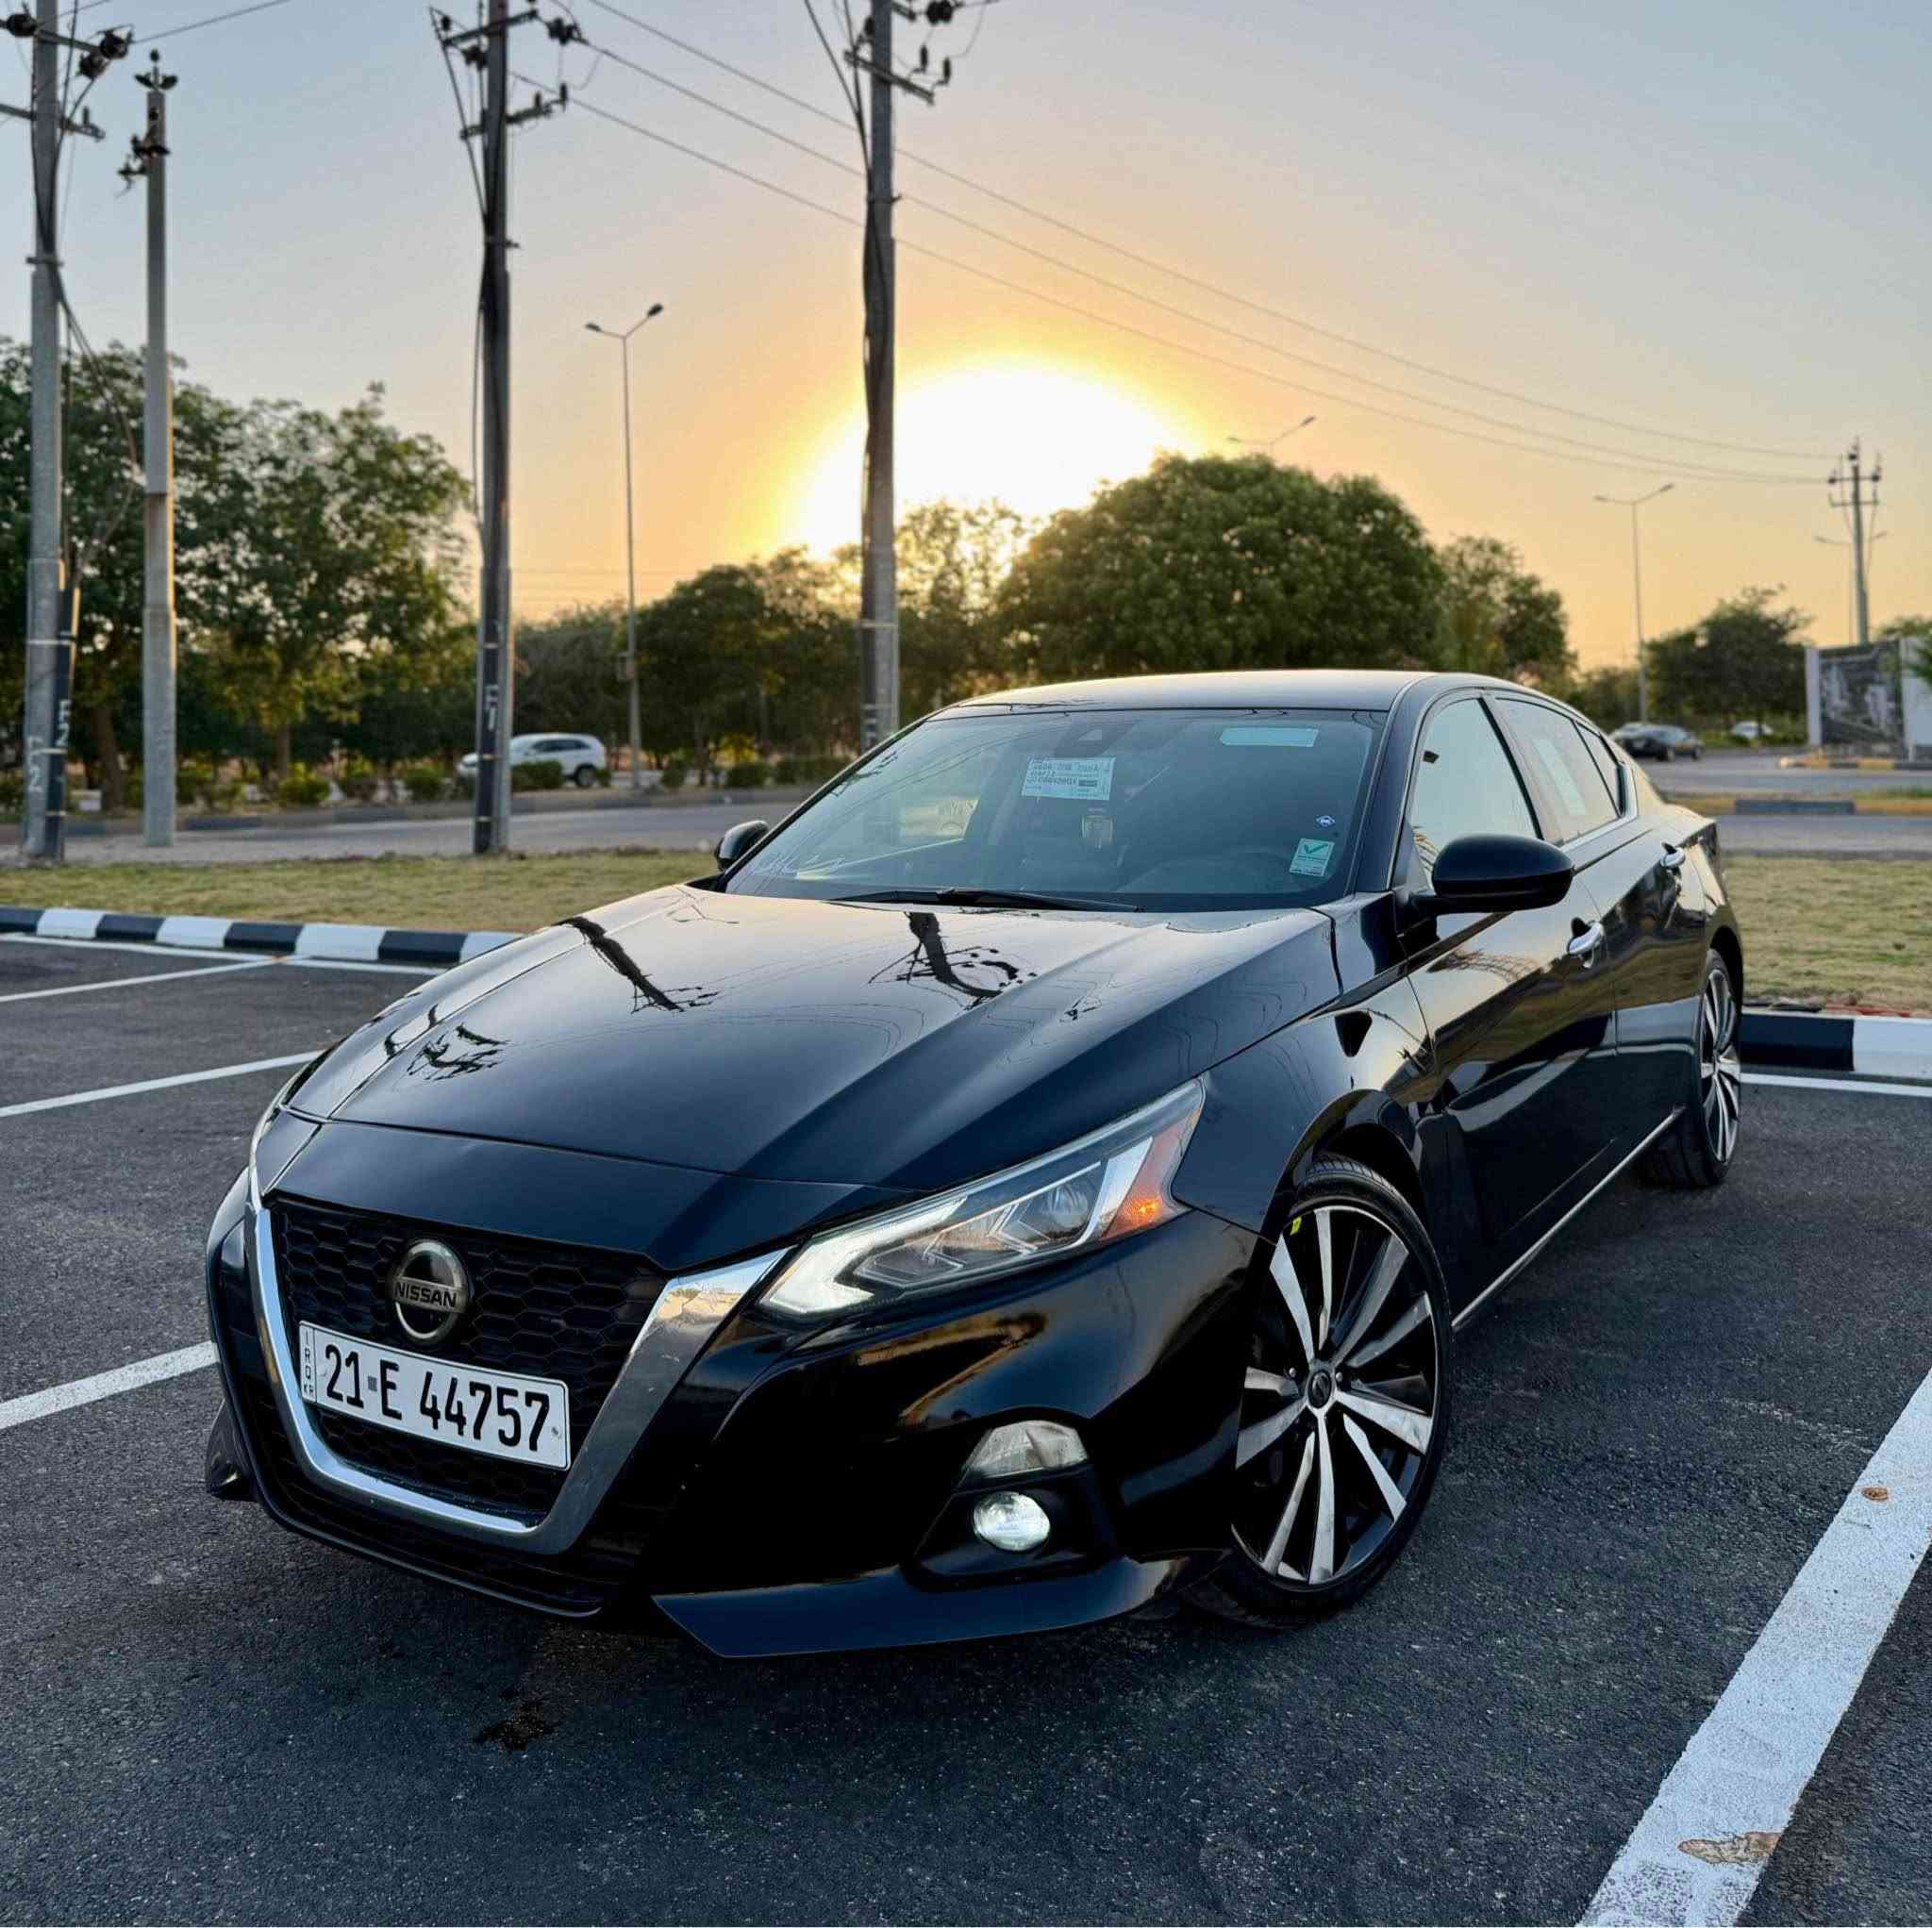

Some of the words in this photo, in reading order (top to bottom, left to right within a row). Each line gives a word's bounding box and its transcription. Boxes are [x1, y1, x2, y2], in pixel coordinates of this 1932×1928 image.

[394, 1282, 457, 1307] NISSAN
[325, 1344, 364, 1409] 21
[379, 1358, 403, 1421] E
[420, 1371, 550, 1452] 44757
